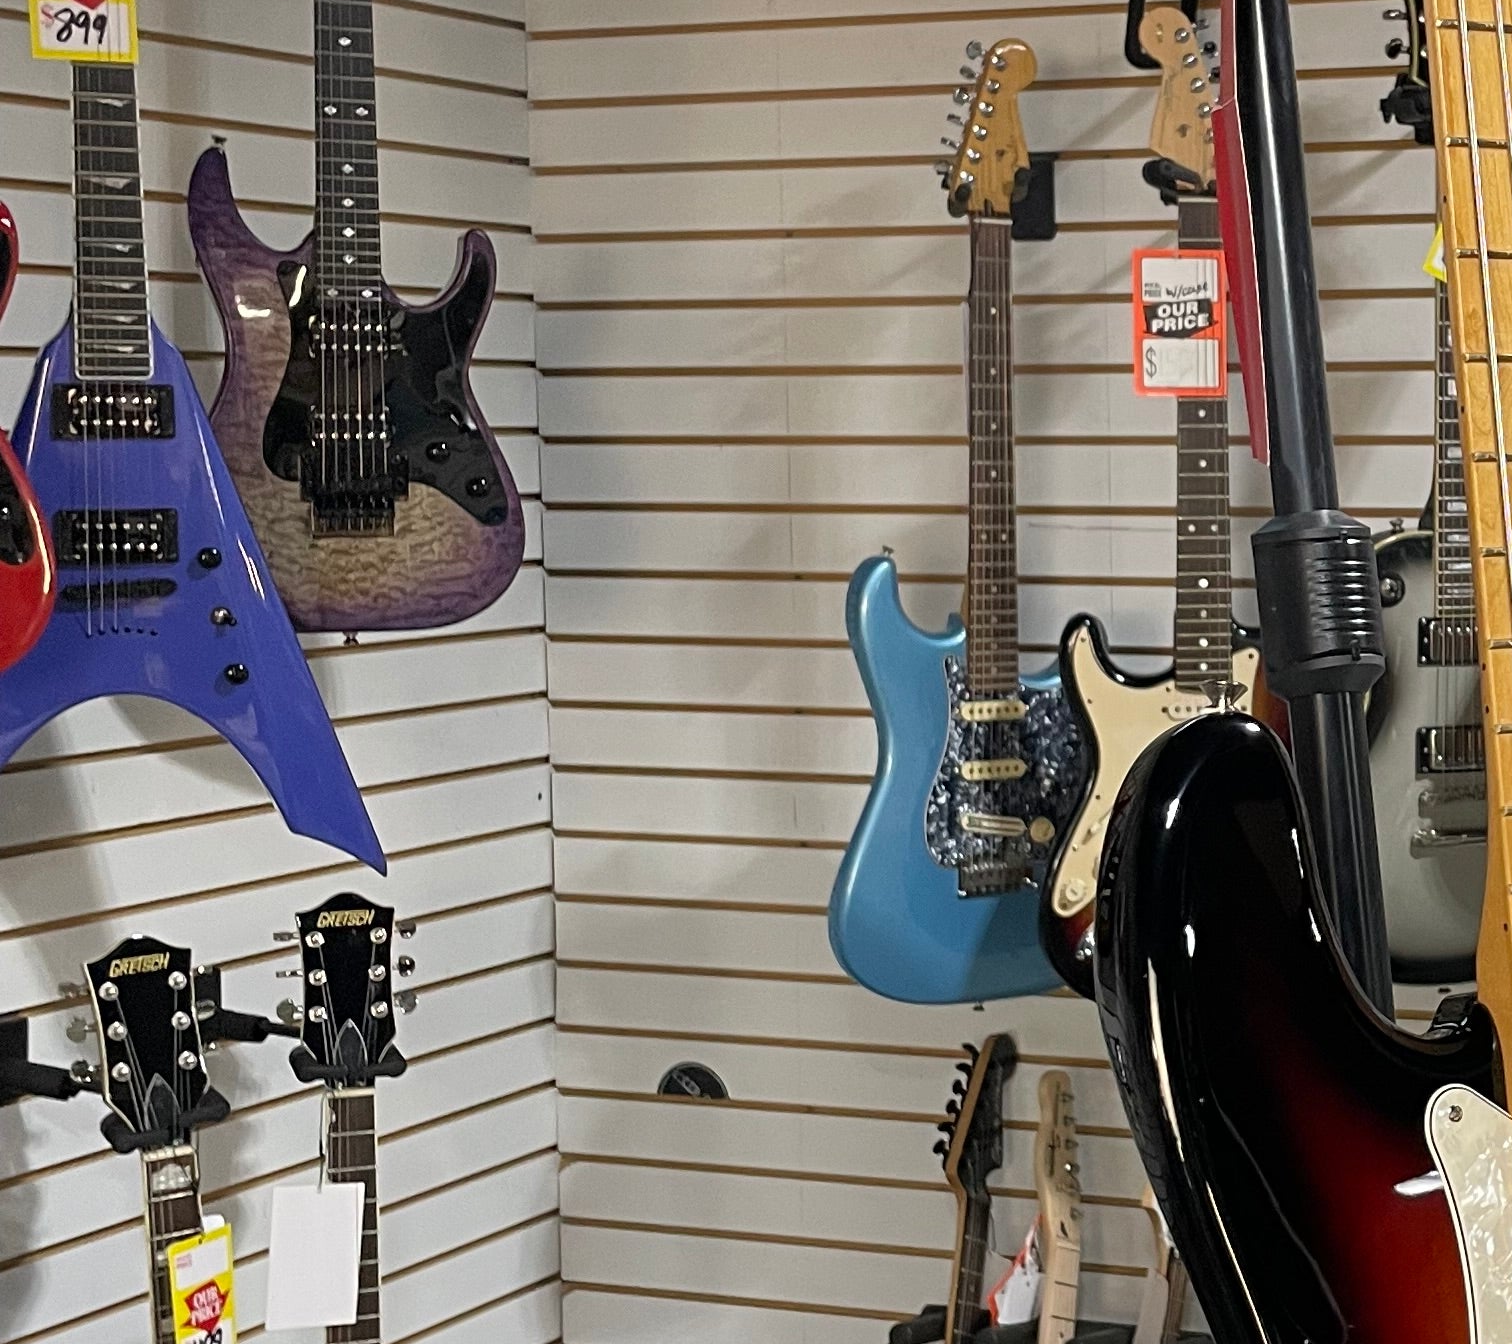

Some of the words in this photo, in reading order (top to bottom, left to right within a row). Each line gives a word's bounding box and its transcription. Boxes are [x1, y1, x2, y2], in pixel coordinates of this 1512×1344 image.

[40, 5, 108, 45] $899
[1157, 300, 1199, 318] OUR
[1151, 312, 1210, 333] PRICE
